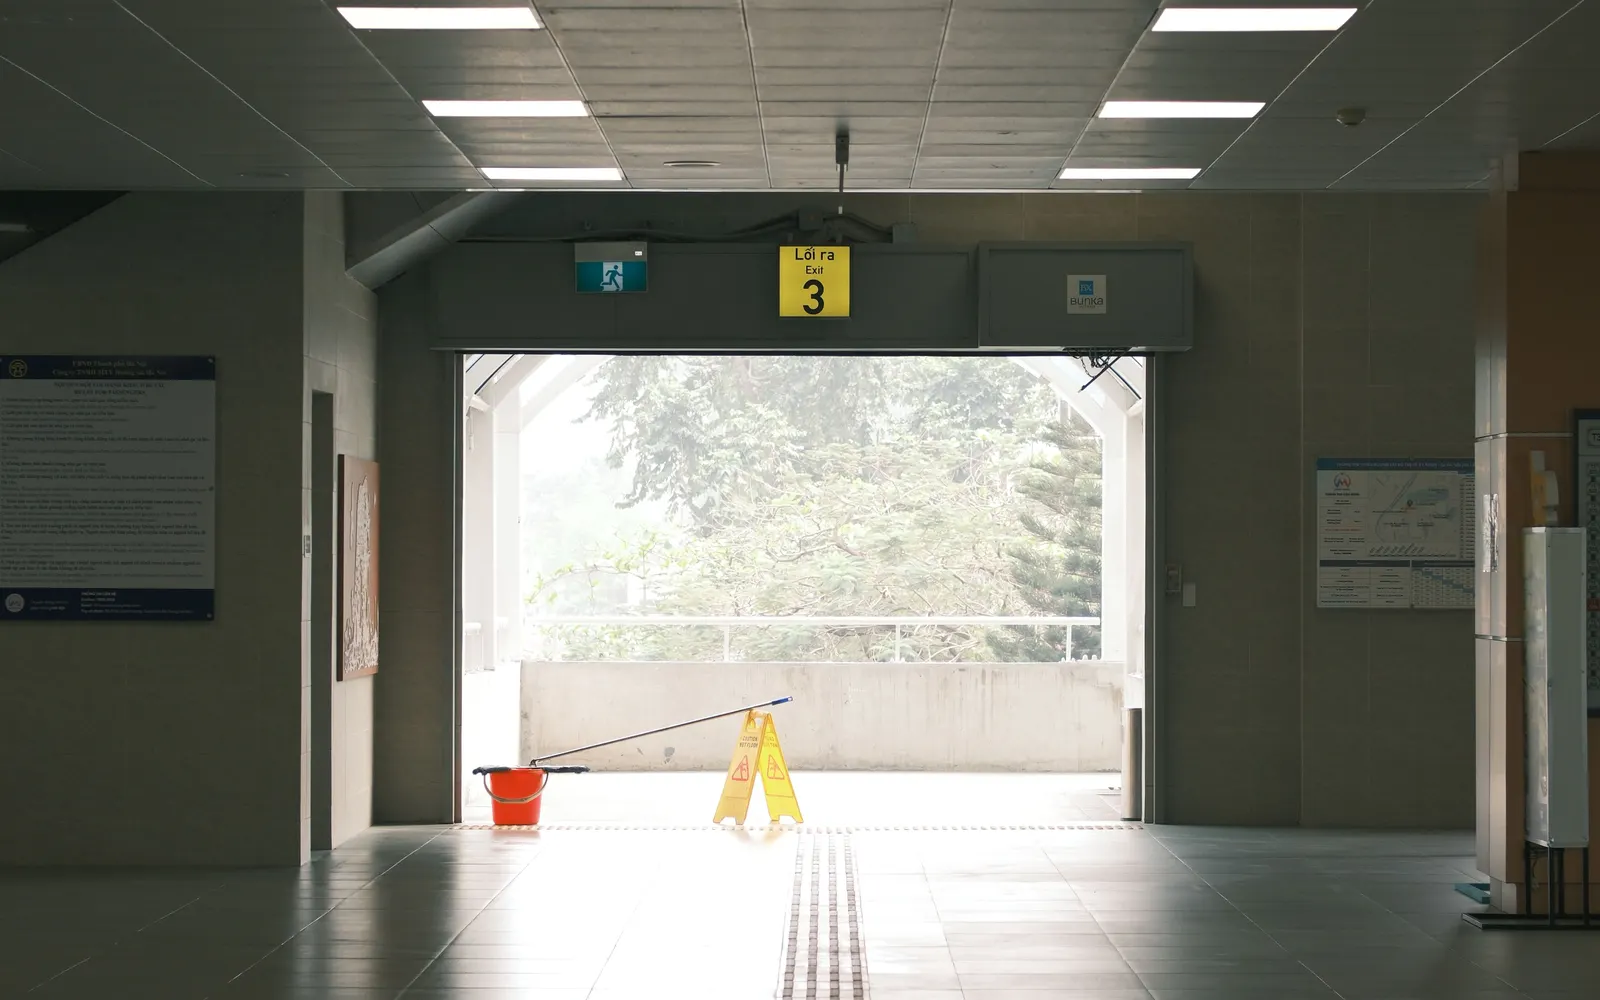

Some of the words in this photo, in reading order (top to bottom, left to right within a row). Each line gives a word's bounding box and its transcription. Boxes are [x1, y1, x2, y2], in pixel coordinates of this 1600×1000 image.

[795, 246, 815, 260] Lối
[820, 251, 835, 260] ra
[805, 265, 824, 274] Exit
[803, 279, 824, 315] 3
